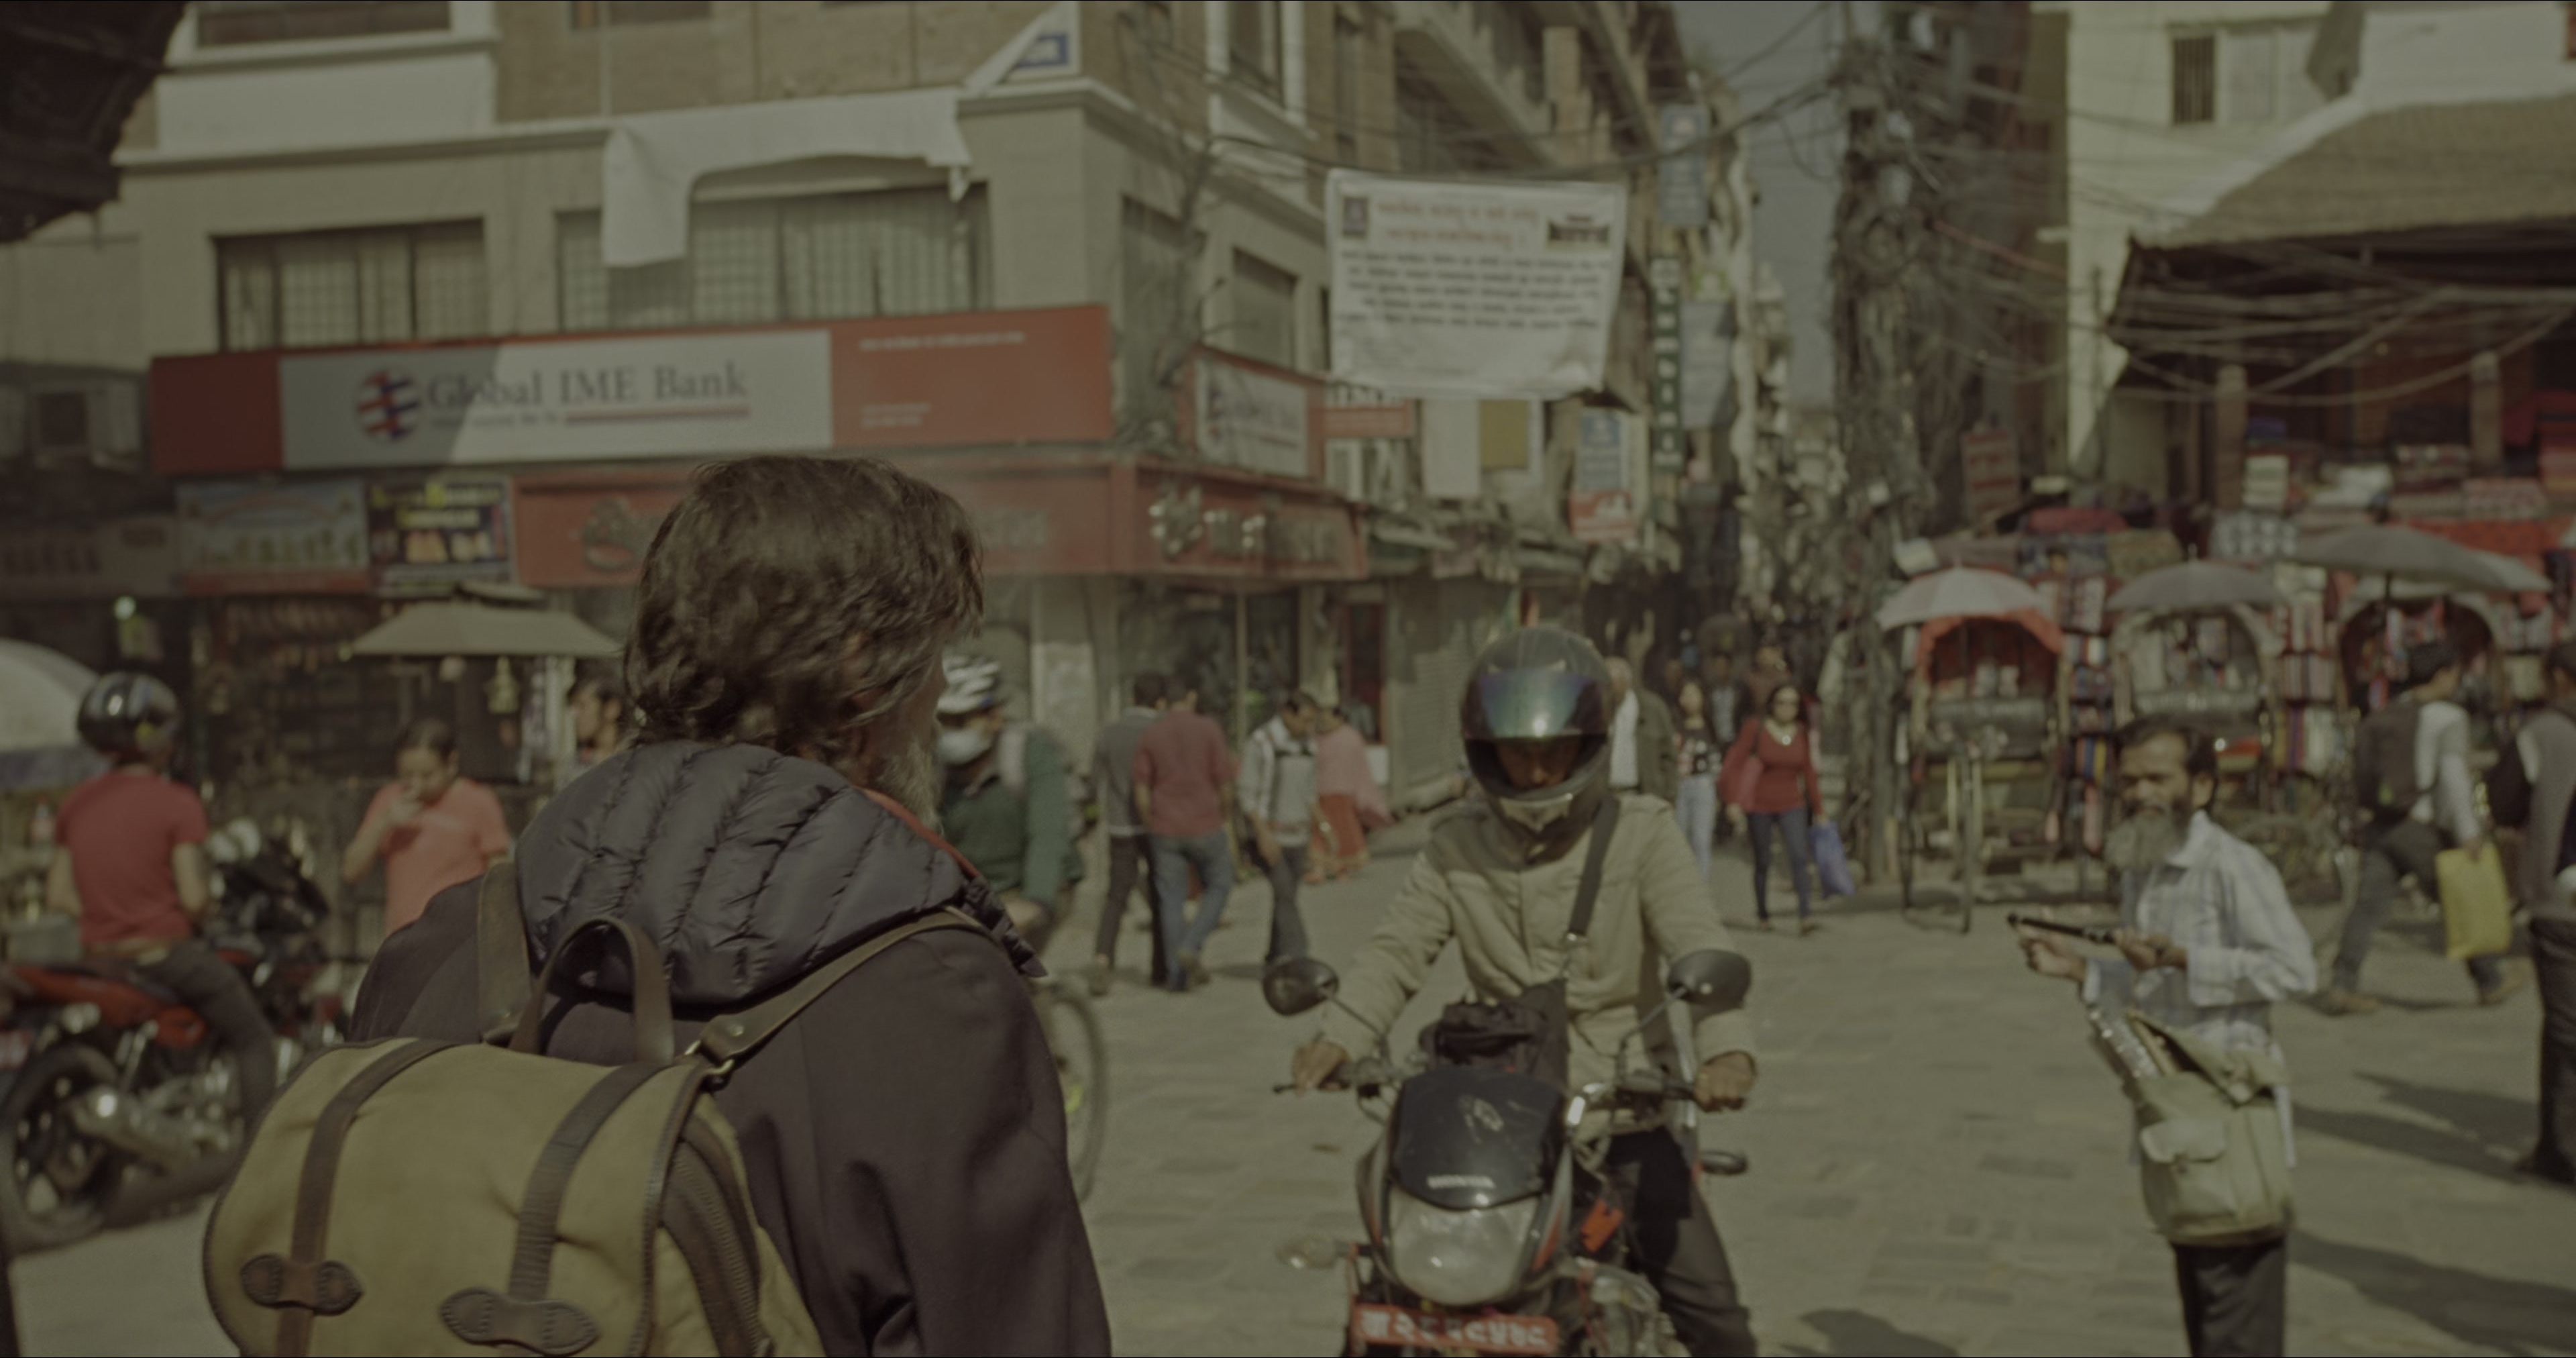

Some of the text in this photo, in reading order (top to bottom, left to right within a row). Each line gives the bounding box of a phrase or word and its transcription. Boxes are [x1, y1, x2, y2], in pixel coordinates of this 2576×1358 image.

[427, 361, 748, 407] Global IME Bank
[1426, 1175, 1496, 1190] HONDA
